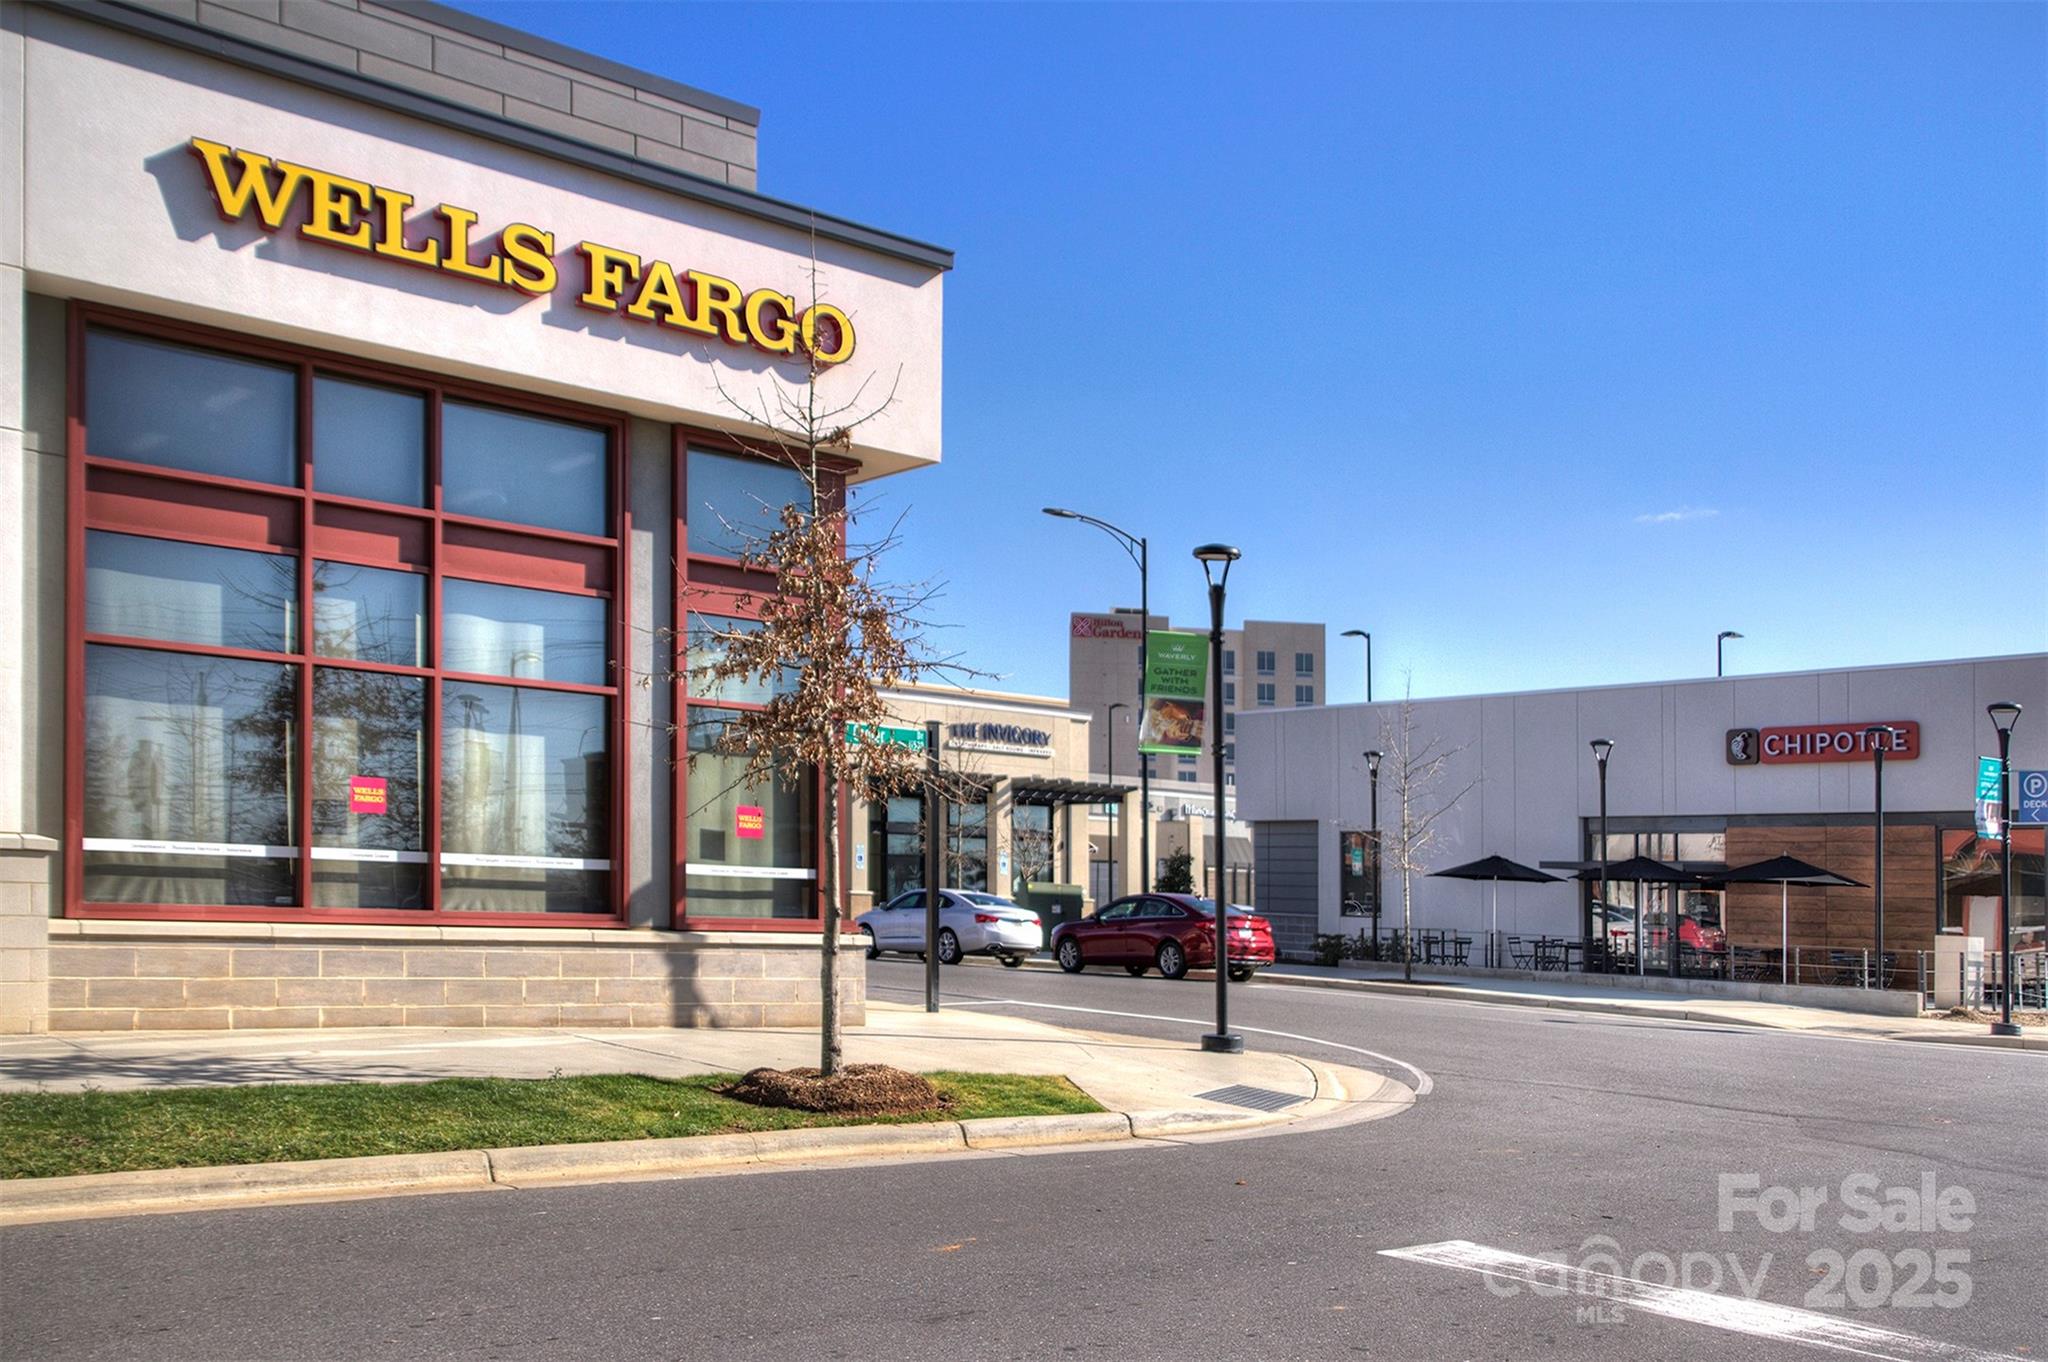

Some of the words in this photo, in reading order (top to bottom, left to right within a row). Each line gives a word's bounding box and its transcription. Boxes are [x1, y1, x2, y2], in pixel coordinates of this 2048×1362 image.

[190, 136, 558, 295] WELLS
[580, 239, 857, 366] FARGO
[1092, 626, 1142, 639] Garden
[1158, 652, 1196, 661] WAVERLY
[1153, 667, 1198, 677] GATHER
[1160, 676, 1189, 685] WITH
[1150, 684, 1198, 695] FRIENDS
[947, 722, 978, 740] THE
[980, 722, 1052, 747] INVIGORY
[1763, 729, 1909, 756] CHIPOTLE
[352, 786, 385, 796] WELLS
[2030, 778, 2042, 794] P
[353, 794, 385, 804] FARGO
[2023, 800, 2048, 809] DECK
[738, 821, 763, 830] FARGO
